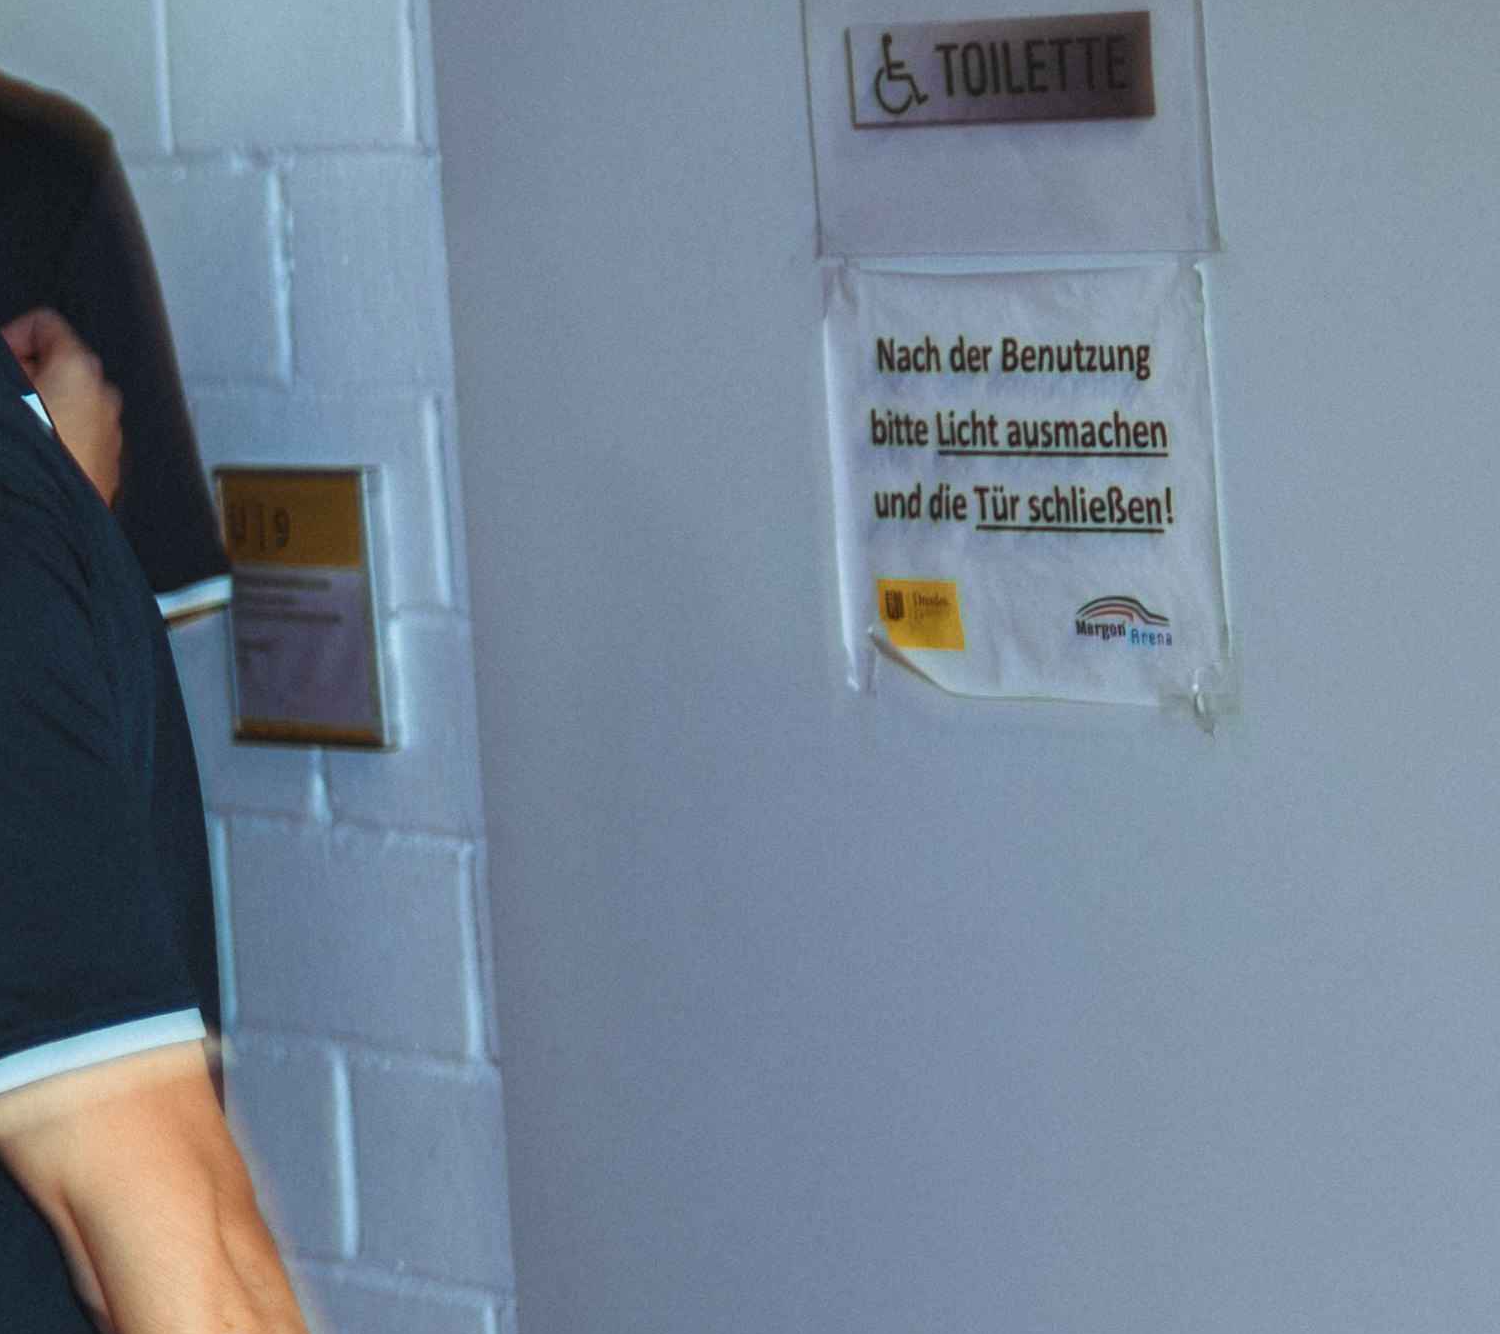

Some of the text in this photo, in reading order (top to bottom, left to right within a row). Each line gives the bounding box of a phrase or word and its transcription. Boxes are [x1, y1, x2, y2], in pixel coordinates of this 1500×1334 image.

[934, 35, 1129, 98] TOILETTE
[876, 335, 1151, 381] Nach der Benutzung
[870, 408, 1168, 449] bitte Licht ausmachen
[874, 482, 1174, 525] und die Tür schließen!
[1075, 619, 1126, 641] Margon
[1131, 628, 1172, 646] Arena
